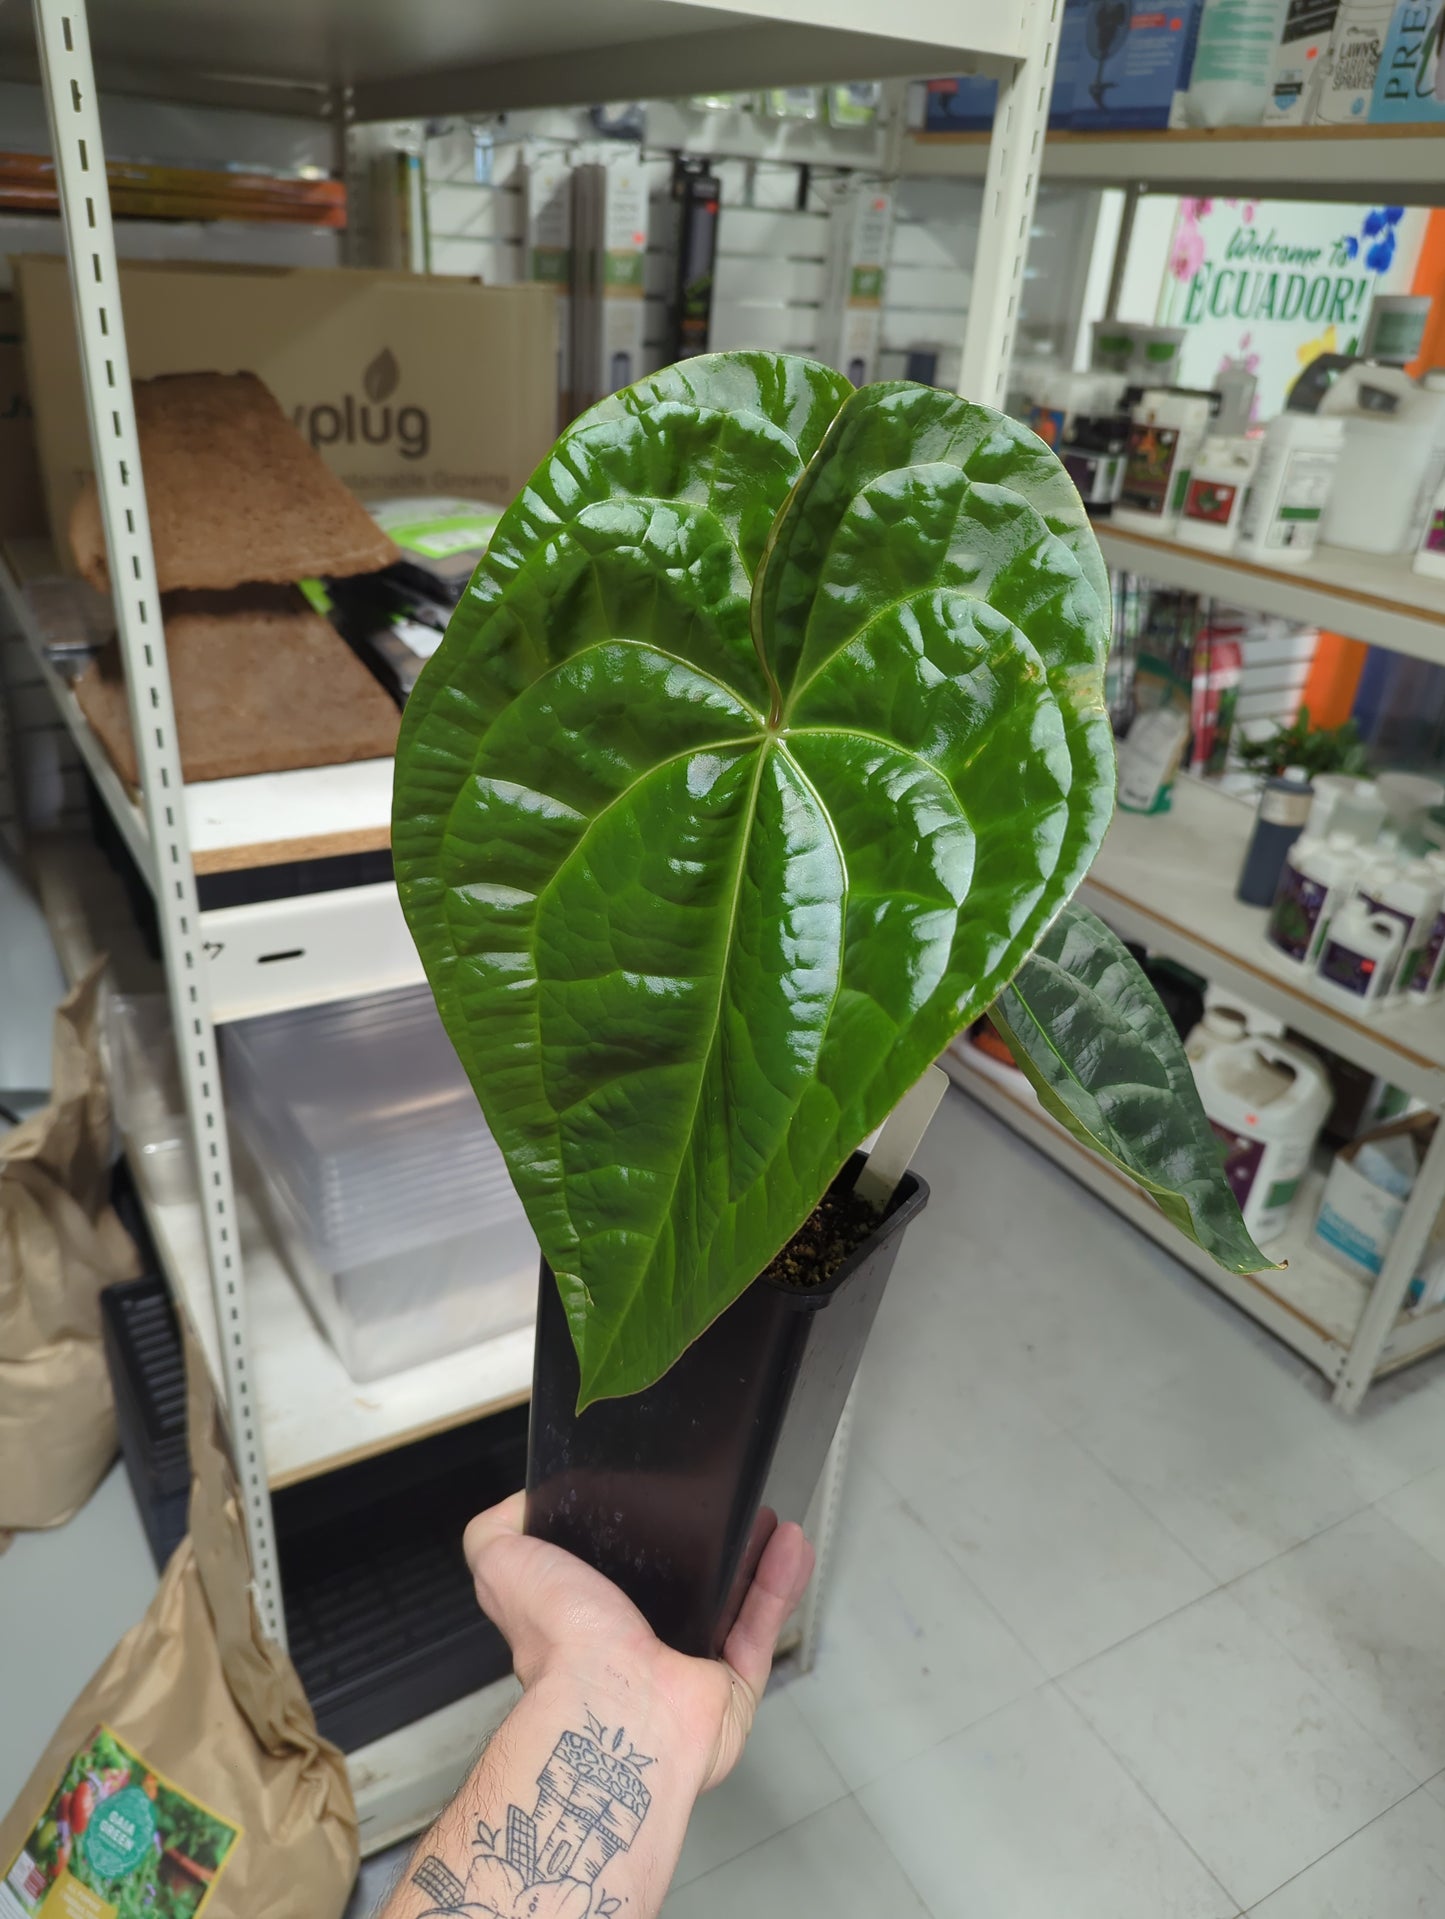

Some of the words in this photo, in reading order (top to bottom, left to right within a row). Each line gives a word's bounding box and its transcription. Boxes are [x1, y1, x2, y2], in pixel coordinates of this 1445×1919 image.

[1384, 0, 1430, 99] PRE
[1226, 227, 1322, 265] Welcome
[1329, 235, 1350, 267] to
[1183, 261, 1367, 324] ECUADOR!
[99, 1819, 135, 1852] GREEN
